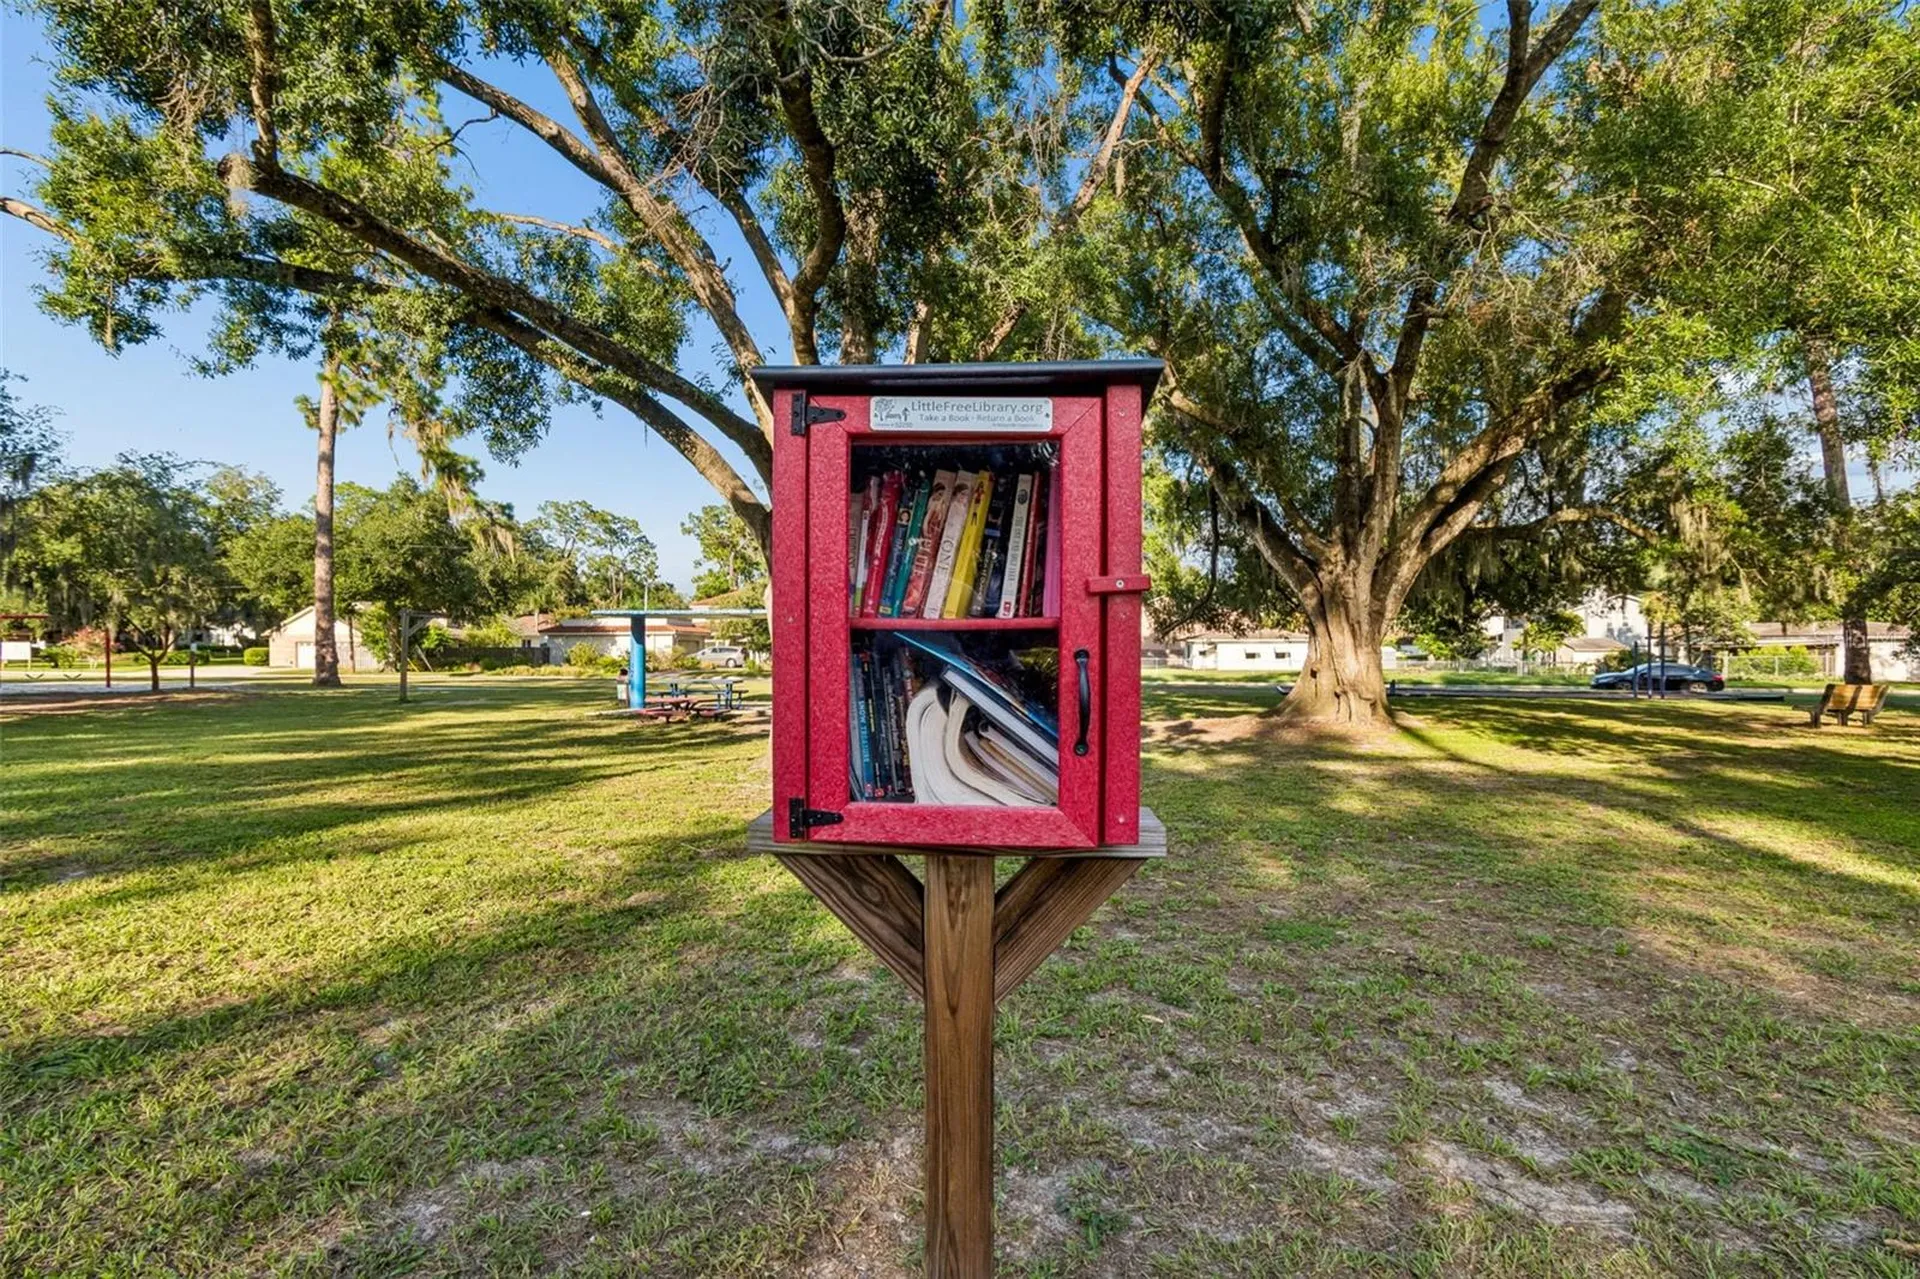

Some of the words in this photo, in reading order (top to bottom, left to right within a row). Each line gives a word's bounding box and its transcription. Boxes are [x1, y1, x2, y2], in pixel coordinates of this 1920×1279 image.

[911, 400, 1043, 414] LittleFreeLibrary.org
[919, 414, 938, 422] Take
[948, 414, 969, 422] Book
[976, 414, 1005, 422] Return
[1014, 414, 1034, 422] Book
[858, 701, 866, 723] SNOW
[861, 726, 870, 762] TREASURE
